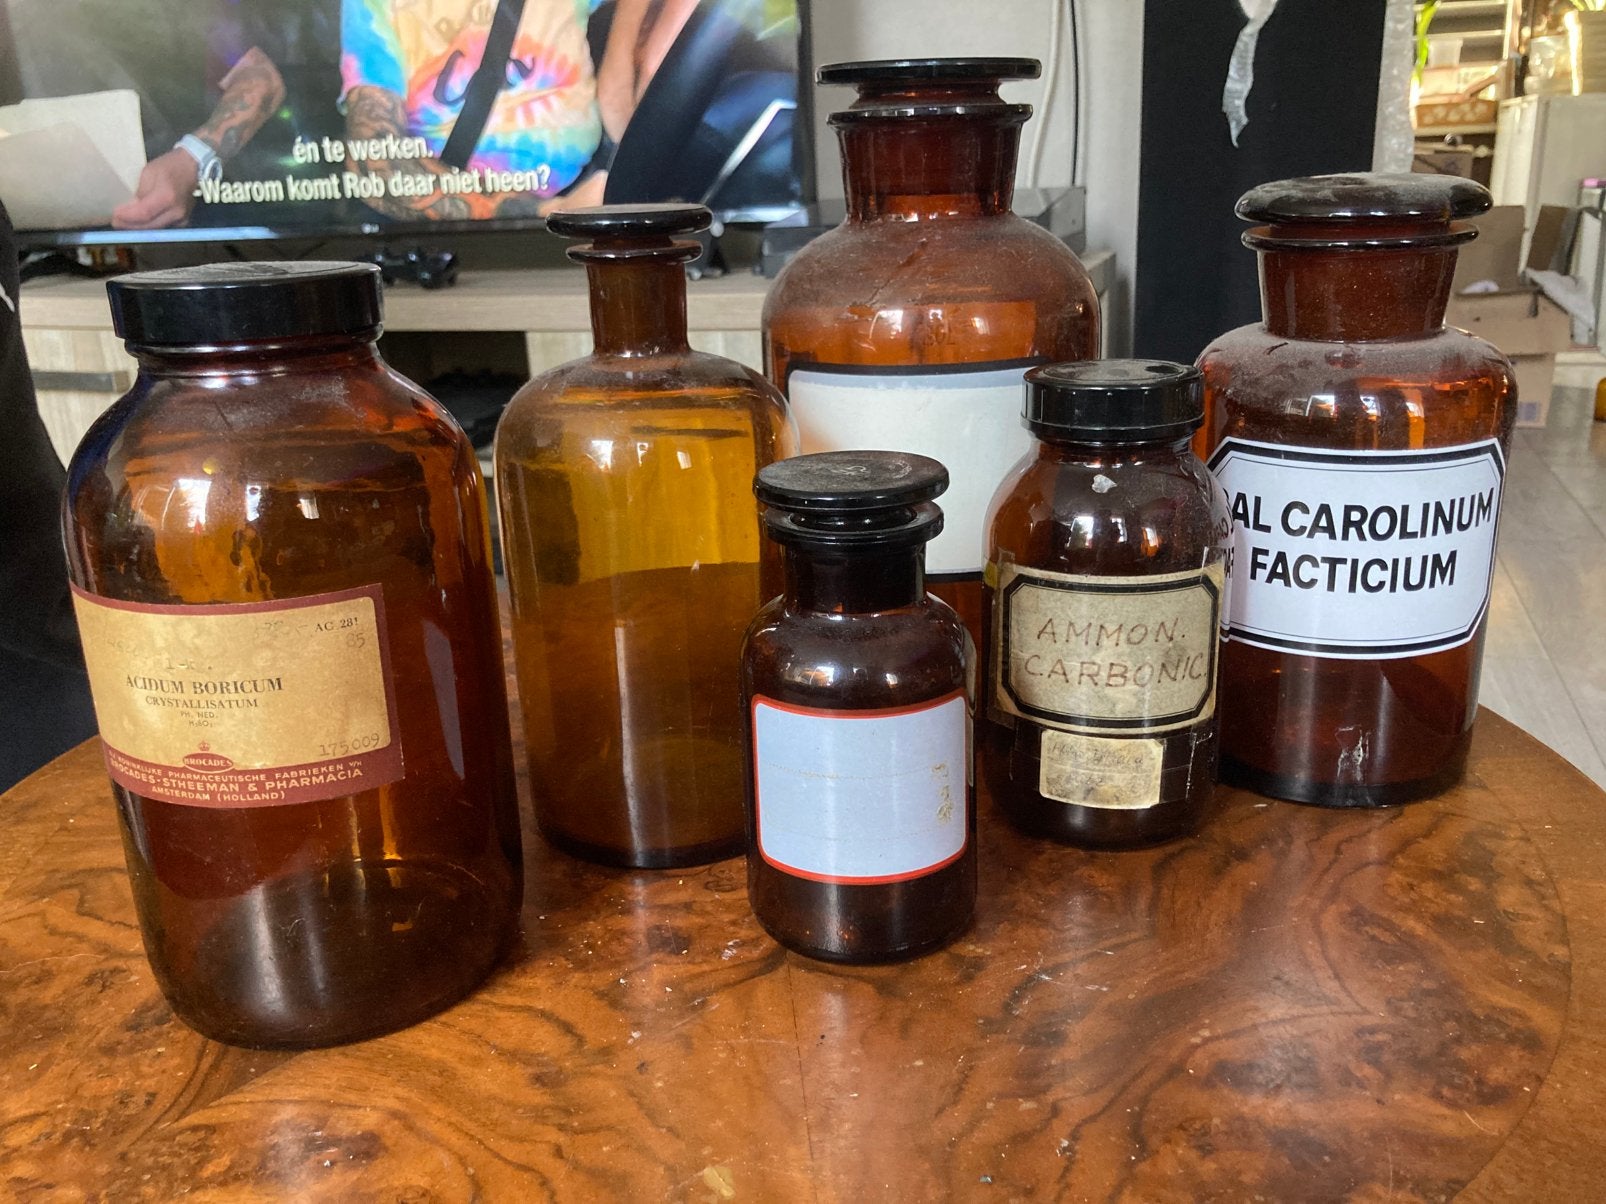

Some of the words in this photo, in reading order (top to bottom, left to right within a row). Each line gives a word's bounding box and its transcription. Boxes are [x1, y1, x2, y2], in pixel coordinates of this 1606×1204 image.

[292, 136, 320, 164] én
[322, 136, 346, 163] te
[348, 135, 434, 162] werken.
[193, 177, 284, 204] -Waarom
[286, 173, 342, 201] komt
[343, 170, 386, 199] Rob
[387, 169, 437, 197] daar
[439, 166, 484, 195] niet
[485, 163, 552, 194] heen?
[1222, 487, 1272, 534] AL
[1280, 486, 1494, 542] CAROLINUM
[1249, 546, 1458, 594] FACTICIUM
[1036, 617, 1186, 647] AMMON.
[126, 674, 185, 695] ACIDUM
[192, 677, 285, 695] BORICUM
[145, 695, 259, 709] CRYSTALLISATUM
[319, 732, 380, 757] 175009
[168, 771, 267, 783] PHARMACEUTISCHE
[274, 763, 344, 780] FABRIEKEN
[184, 757, 233, 767] BROCADES
[247, 783, 258, 792] &
[265, 768, 363, 791] PHARMACIA
[152, 786, 211, 801] AMSTERDAM
[217, 790, 286, 802] (HOLLAND)
